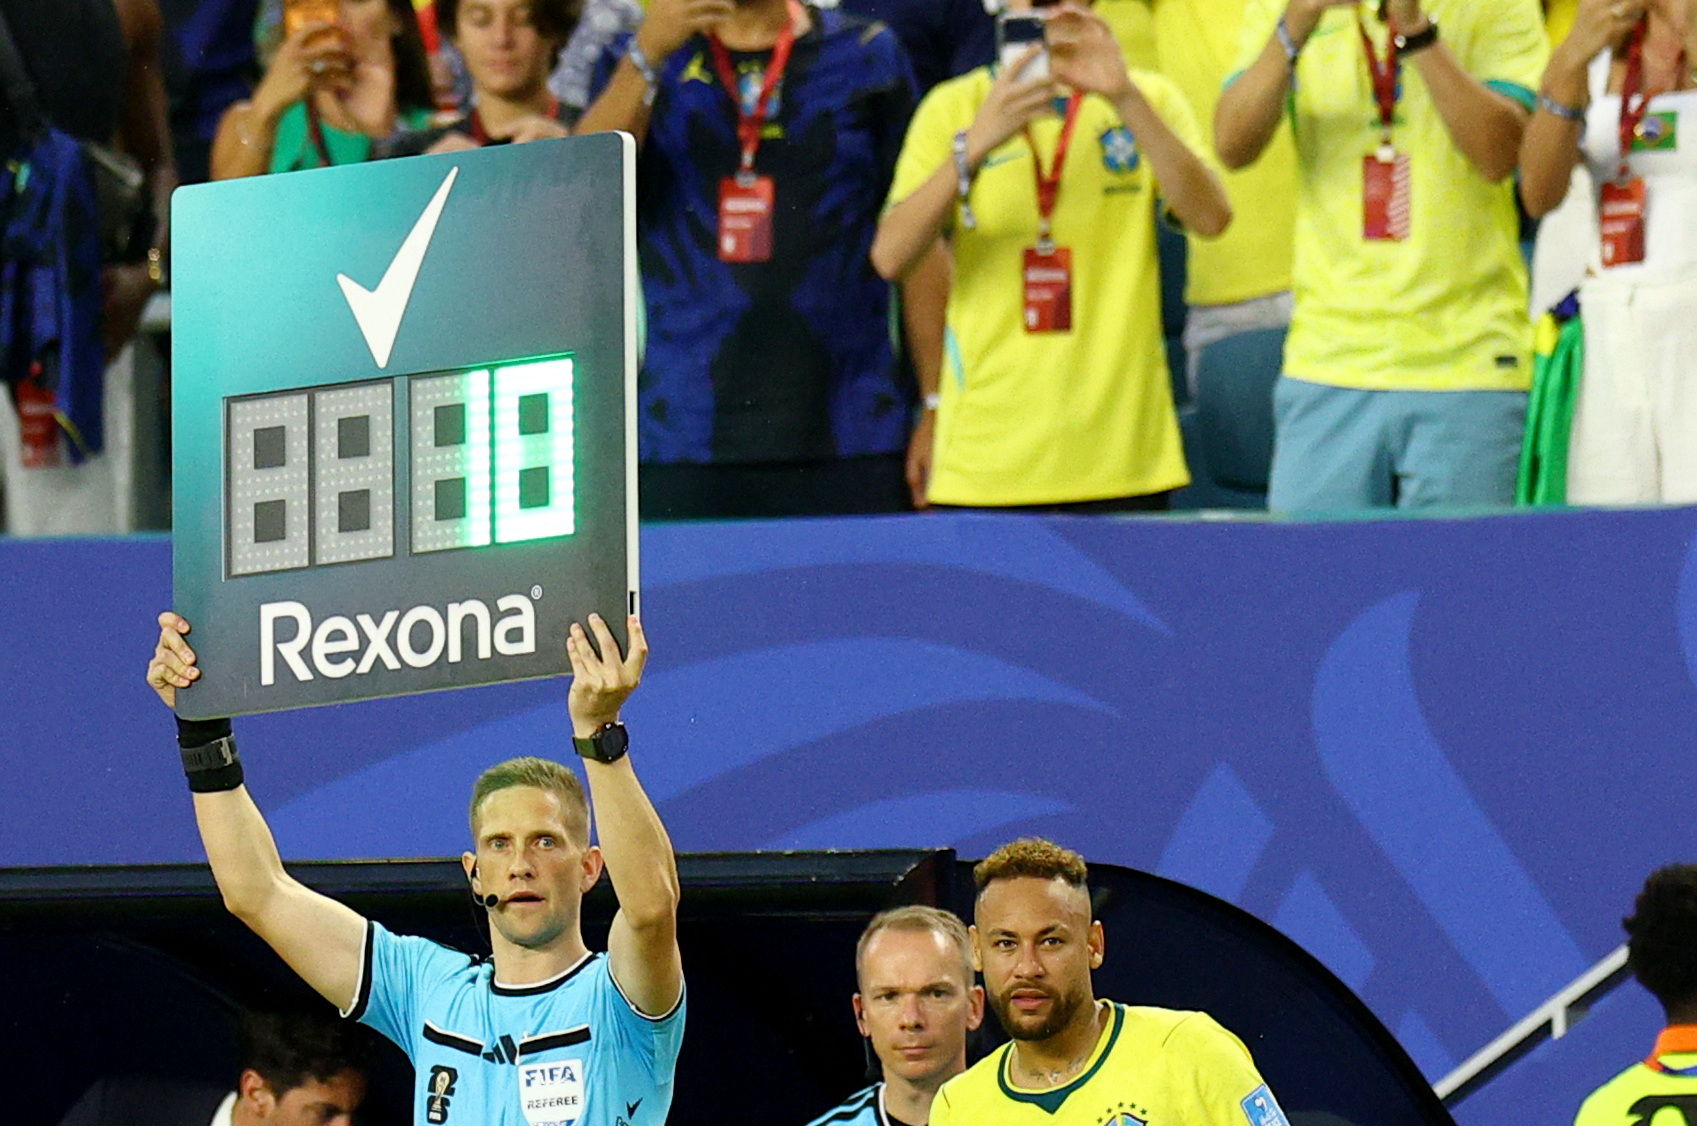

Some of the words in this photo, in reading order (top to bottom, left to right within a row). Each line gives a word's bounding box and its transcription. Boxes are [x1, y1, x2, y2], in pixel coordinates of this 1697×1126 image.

[468, 359, 575, 547] 10
[525, 1065, 577, 1087] FIFA
[527, 1095, 579, 1110] REFEREE
